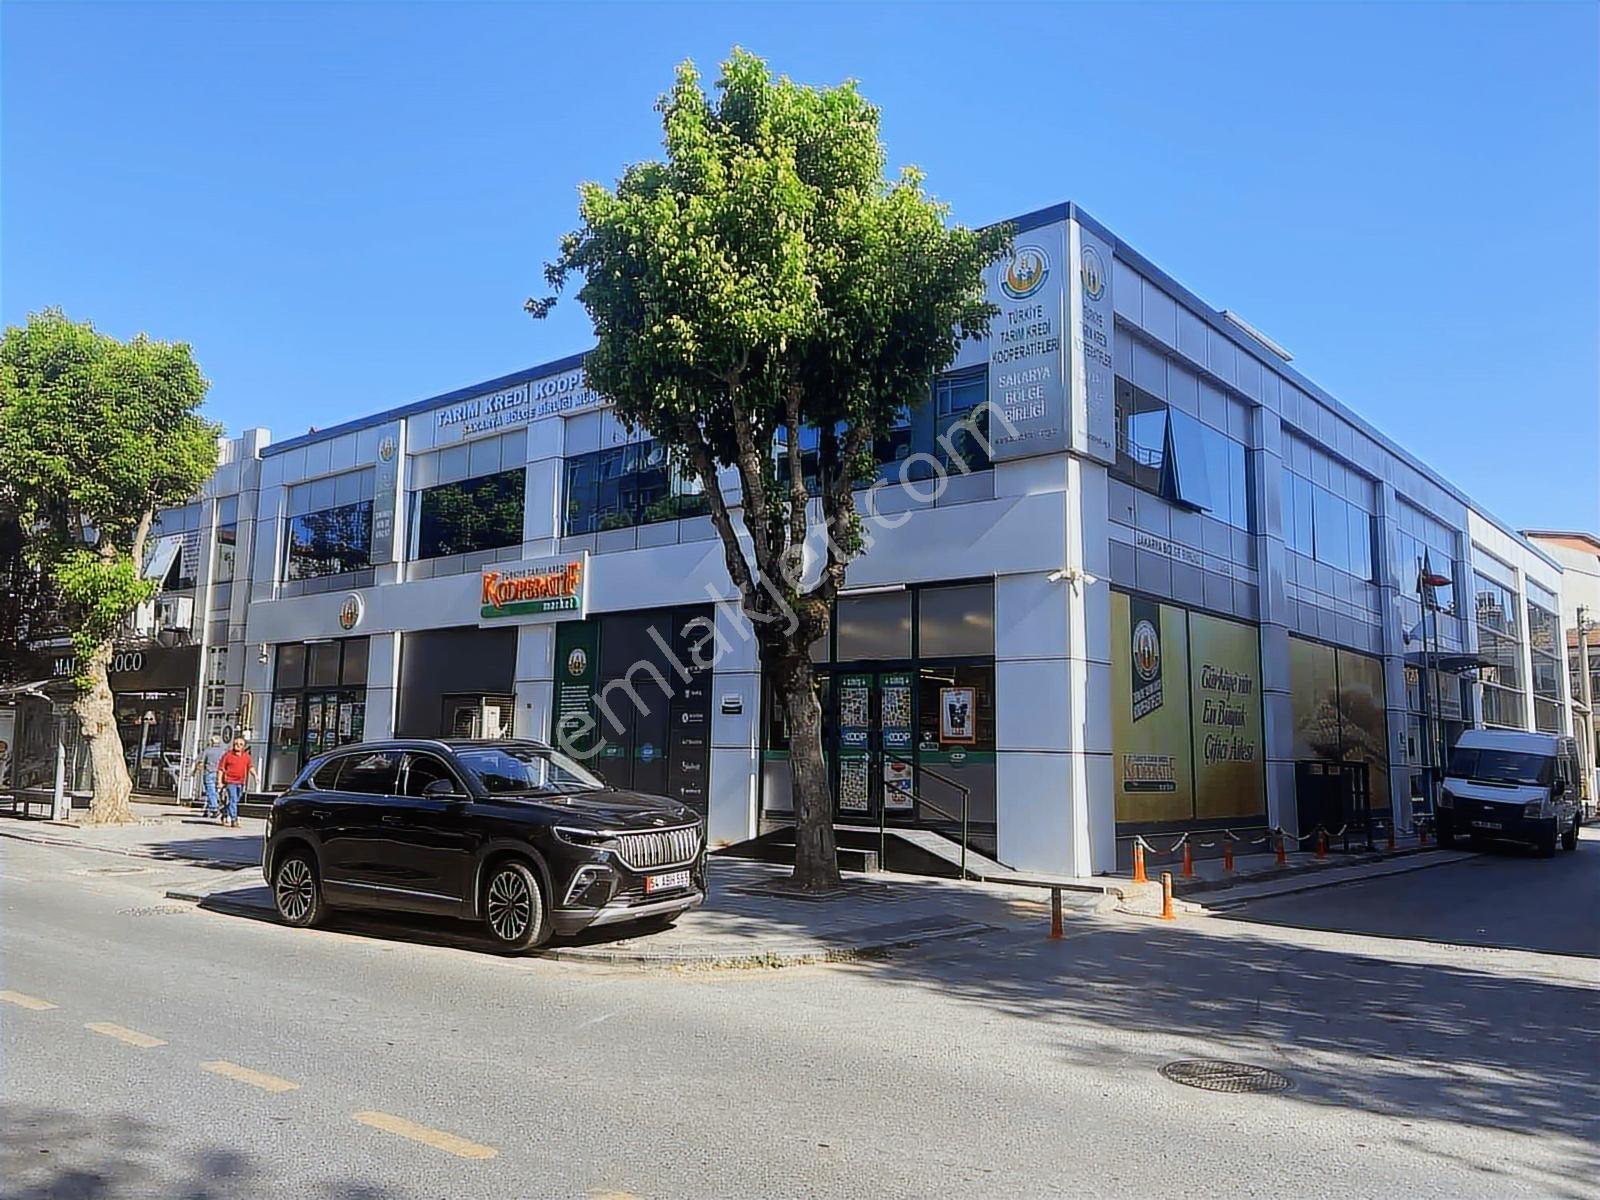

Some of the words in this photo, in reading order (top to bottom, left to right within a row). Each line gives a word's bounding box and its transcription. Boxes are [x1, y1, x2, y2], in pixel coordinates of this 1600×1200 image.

[1000, 325, 1025, 343] TARIM
[1026, 318, 1051, 339] KREDİ
[999, 366, 1052, 388] SAKARYA
[437, 401, 481, 427] TARIM
[484, 383, 530, 414] KREDİ
[535, 372, 588, 401] KOOPE
[1005, 384, 1044, 405] BÖLGE
[504, 408, 536, 424] BÖLGE
[482, 562, 582, 608] KOOPERATİF
[542, 598, 575, 612] market
